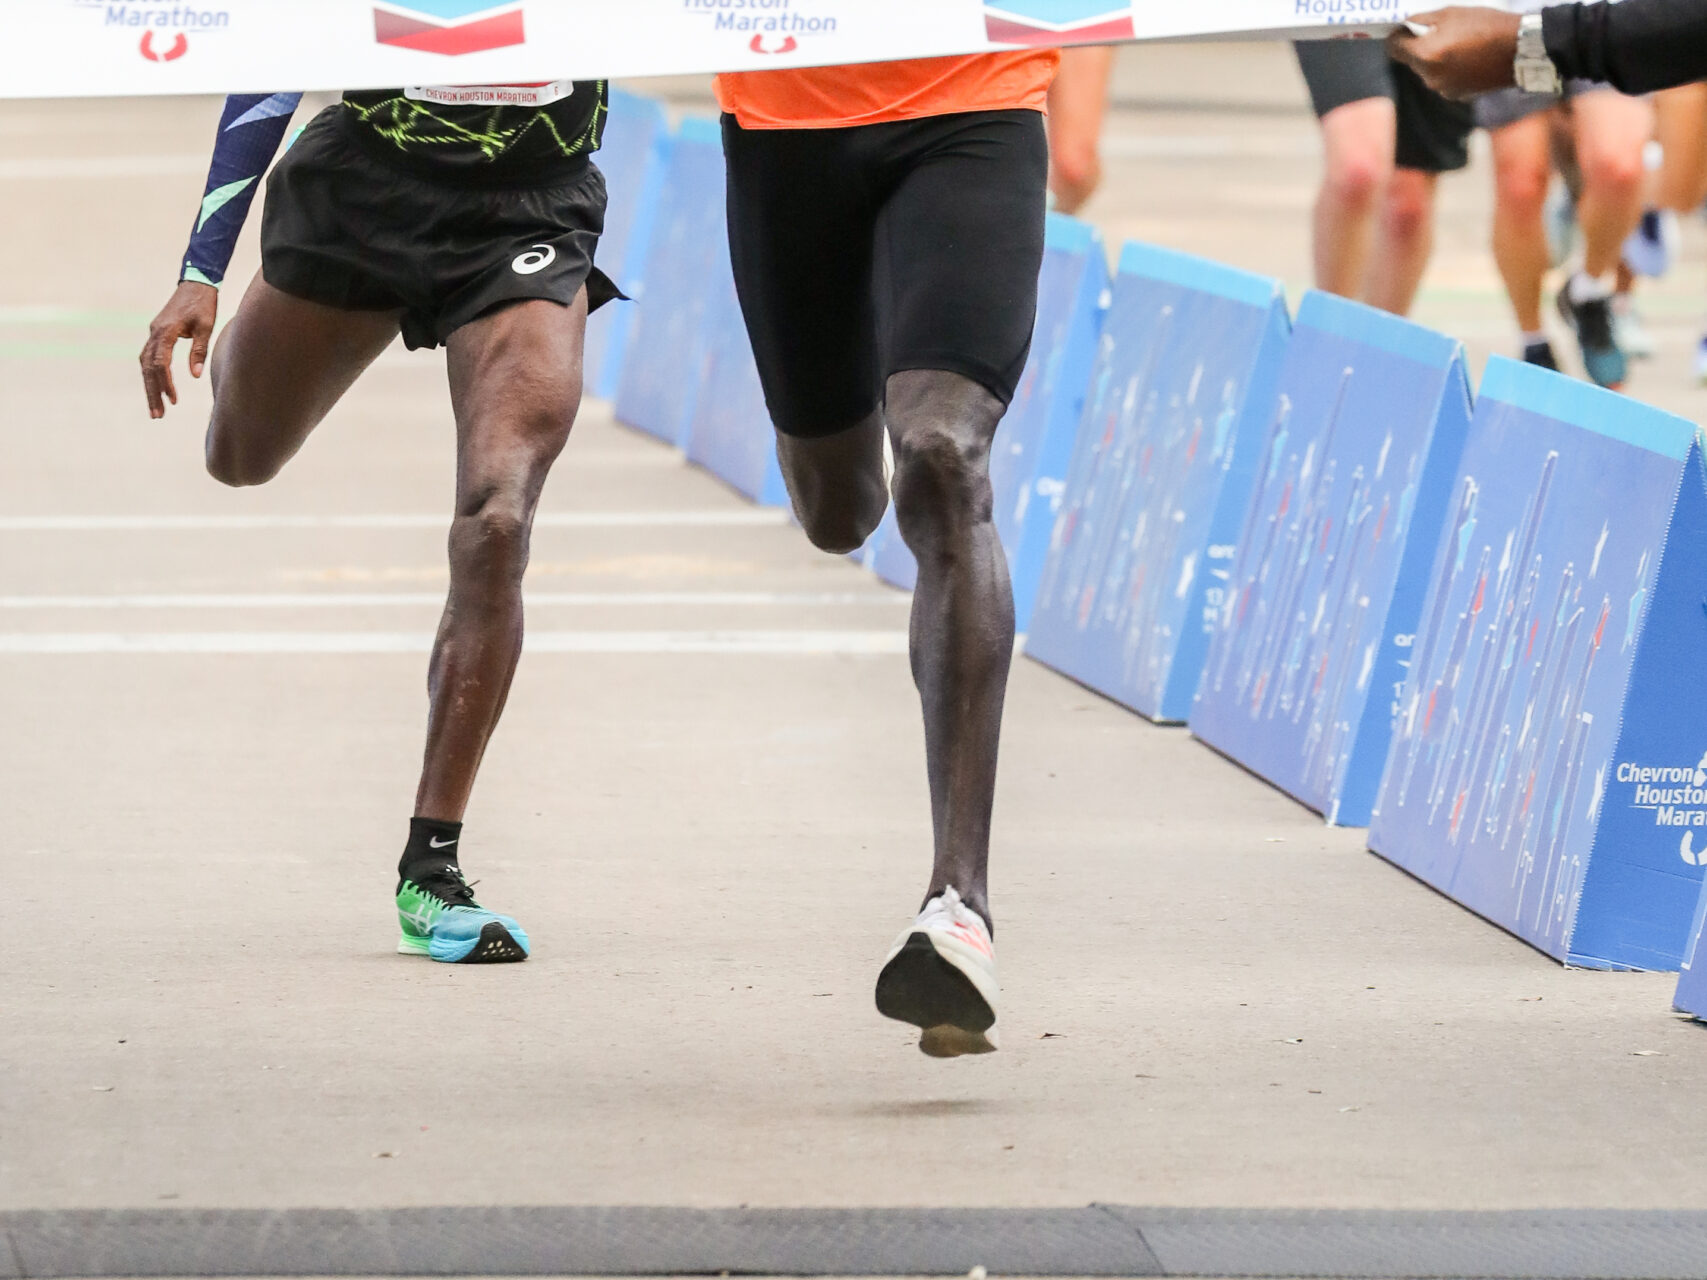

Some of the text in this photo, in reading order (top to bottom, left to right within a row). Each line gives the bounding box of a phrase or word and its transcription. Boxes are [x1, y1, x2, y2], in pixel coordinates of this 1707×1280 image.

[104, 5, 229, 27] Marathon
[714, 11, 837, 31] Marathon
[425, 88, 457, 101] CHEVRON
[459, 91, 494, 102] HOUSTON
[496, 92, 537, 103] MARATHON
[1617, 762, 1693, 783] Chevron
[1655, 806, 1707, 826] Mara
